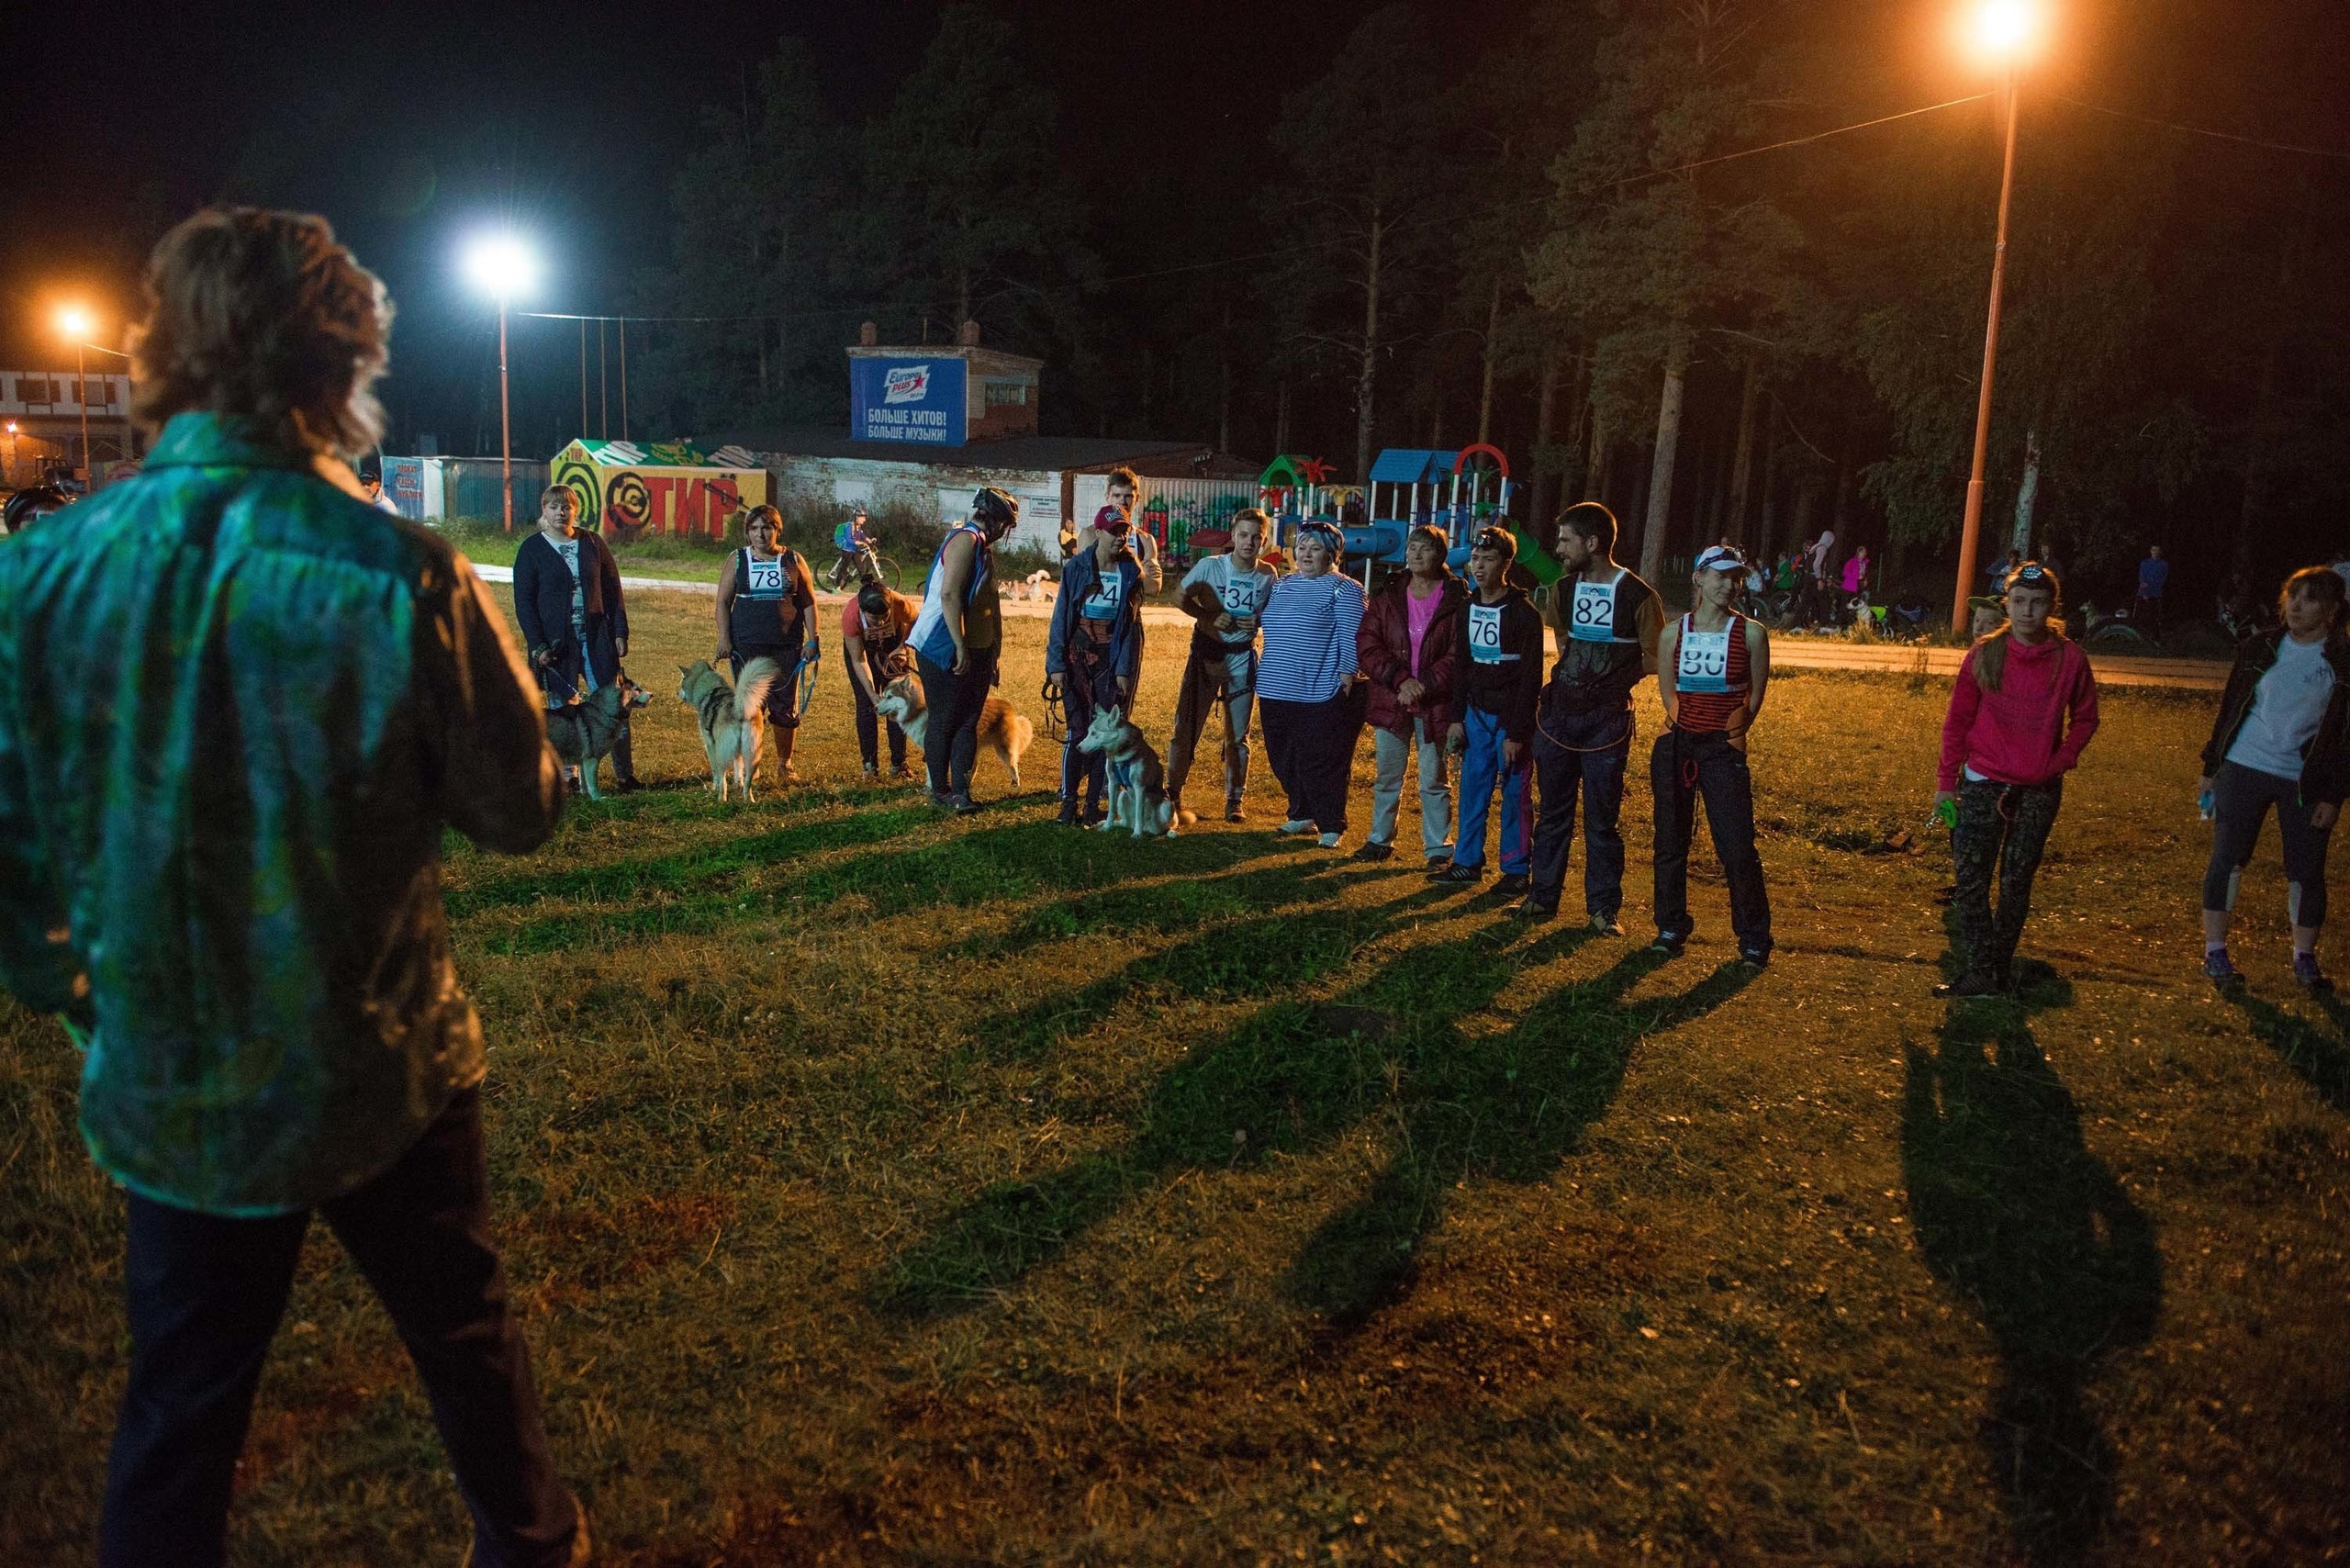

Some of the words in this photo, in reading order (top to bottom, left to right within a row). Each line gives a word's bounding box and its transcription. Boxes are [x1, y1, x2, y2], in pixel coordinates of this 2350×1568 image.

[868, 409, 909, 424] БОЛЬШЕ
[912, 410, 946, 426] ХИТОВ!
[868, 425, 903, 439] БОЛЬШЕ
[906, 428, 946, 442] МУЗЫКИ!
[643, 476, 738, 539] ТИР
[751, 570, 780, 588] 78
[1226, 588, 1254, 610] 34
[1575, 598, 1612, 626] 82
[1472, 620, 1498, 645] 76
[1683, 650, 1725, 676] 80
